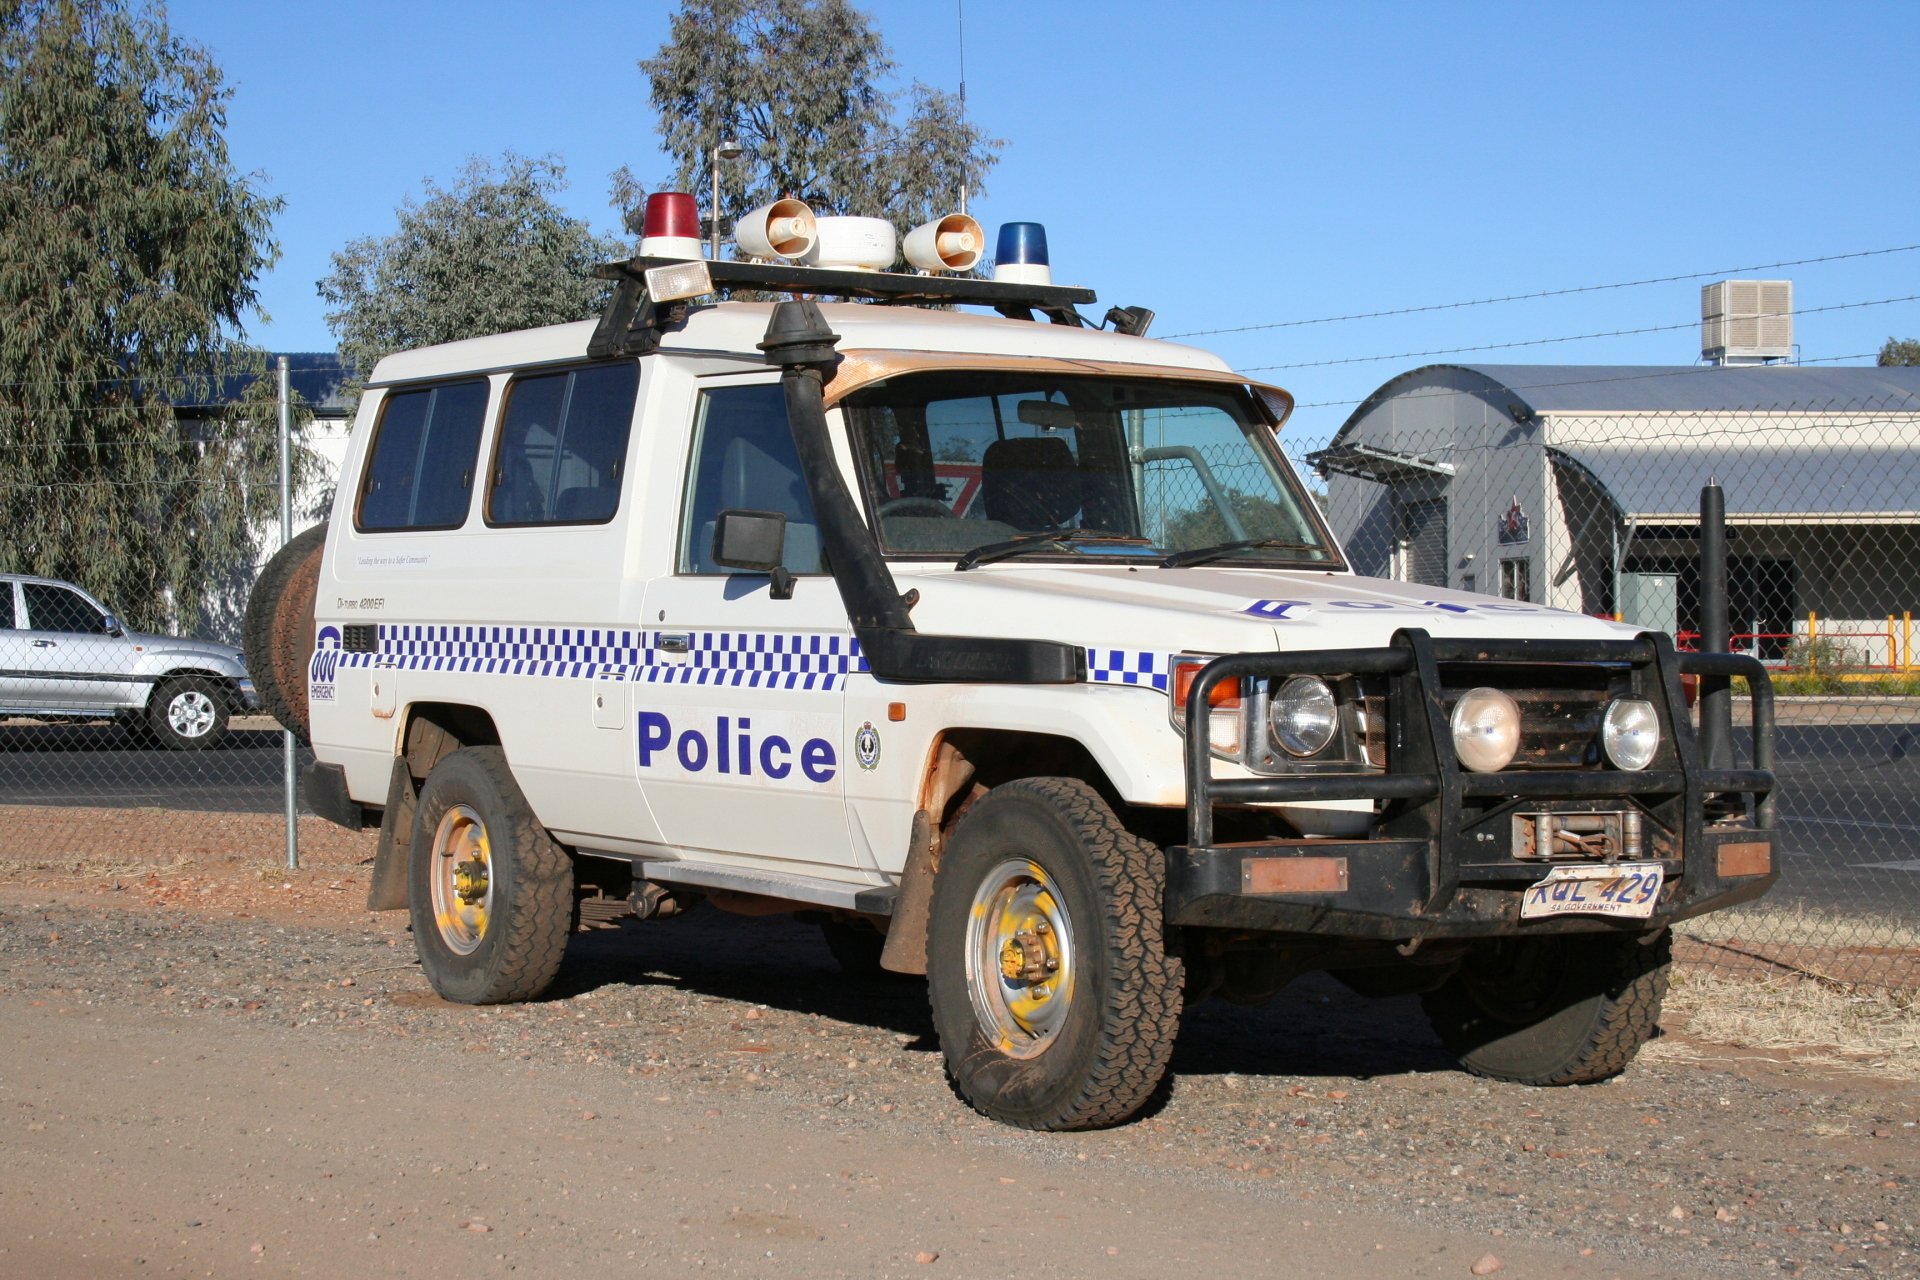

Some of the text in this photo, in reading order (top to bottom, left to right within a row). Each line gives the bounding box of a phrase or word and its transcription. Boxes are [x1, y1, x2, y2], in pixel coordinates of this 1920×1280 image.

[312, 650, 338, 682] 000
[311, 685, 335, 698] EMERGENCY
[638, 711, 837, 783] Police
[1600, 873, 1658, 904] 429
[1564, 903, 1622, 911] GOVERNMENT
